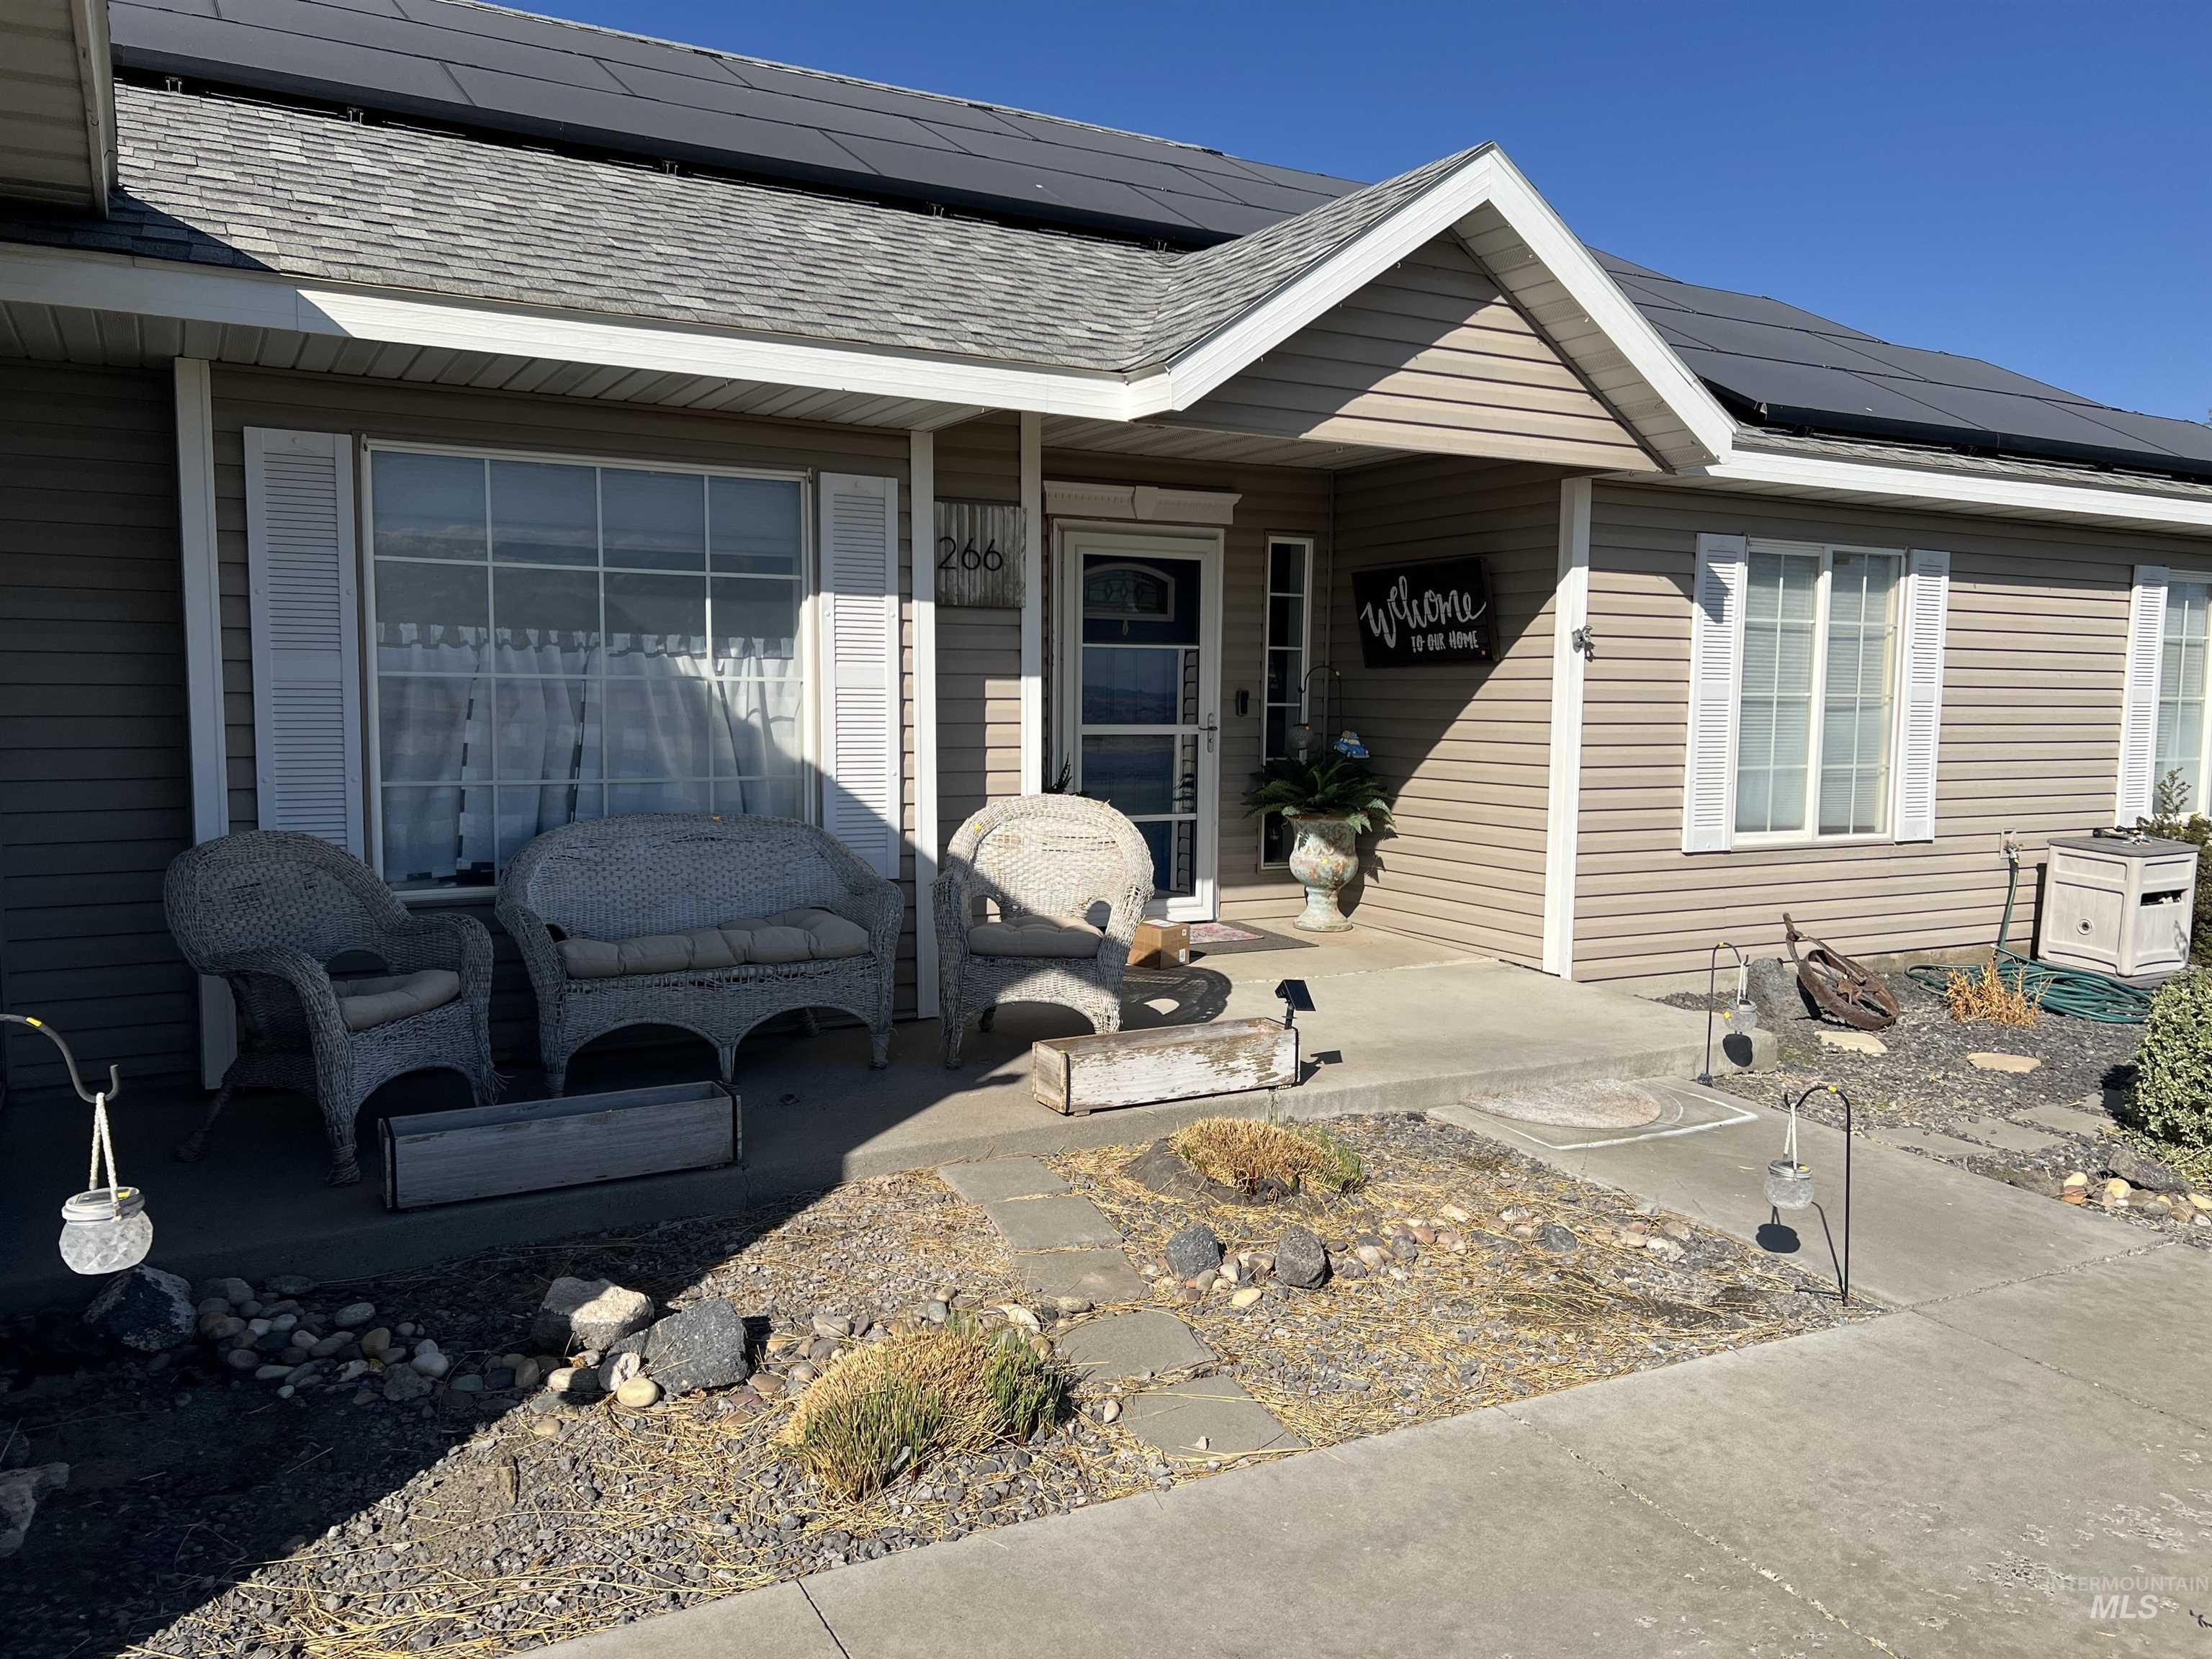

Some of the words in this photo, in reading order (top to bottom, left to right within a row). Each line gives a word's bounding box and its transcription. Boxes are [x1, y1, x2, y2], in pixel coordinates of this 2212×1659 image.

[938, 536, 1003, 571] 266
[1411, 634, 1424, 653] TO
[1427, 633, 1446, 651] OUR
[1449, 630, 1479, 649] HOME
